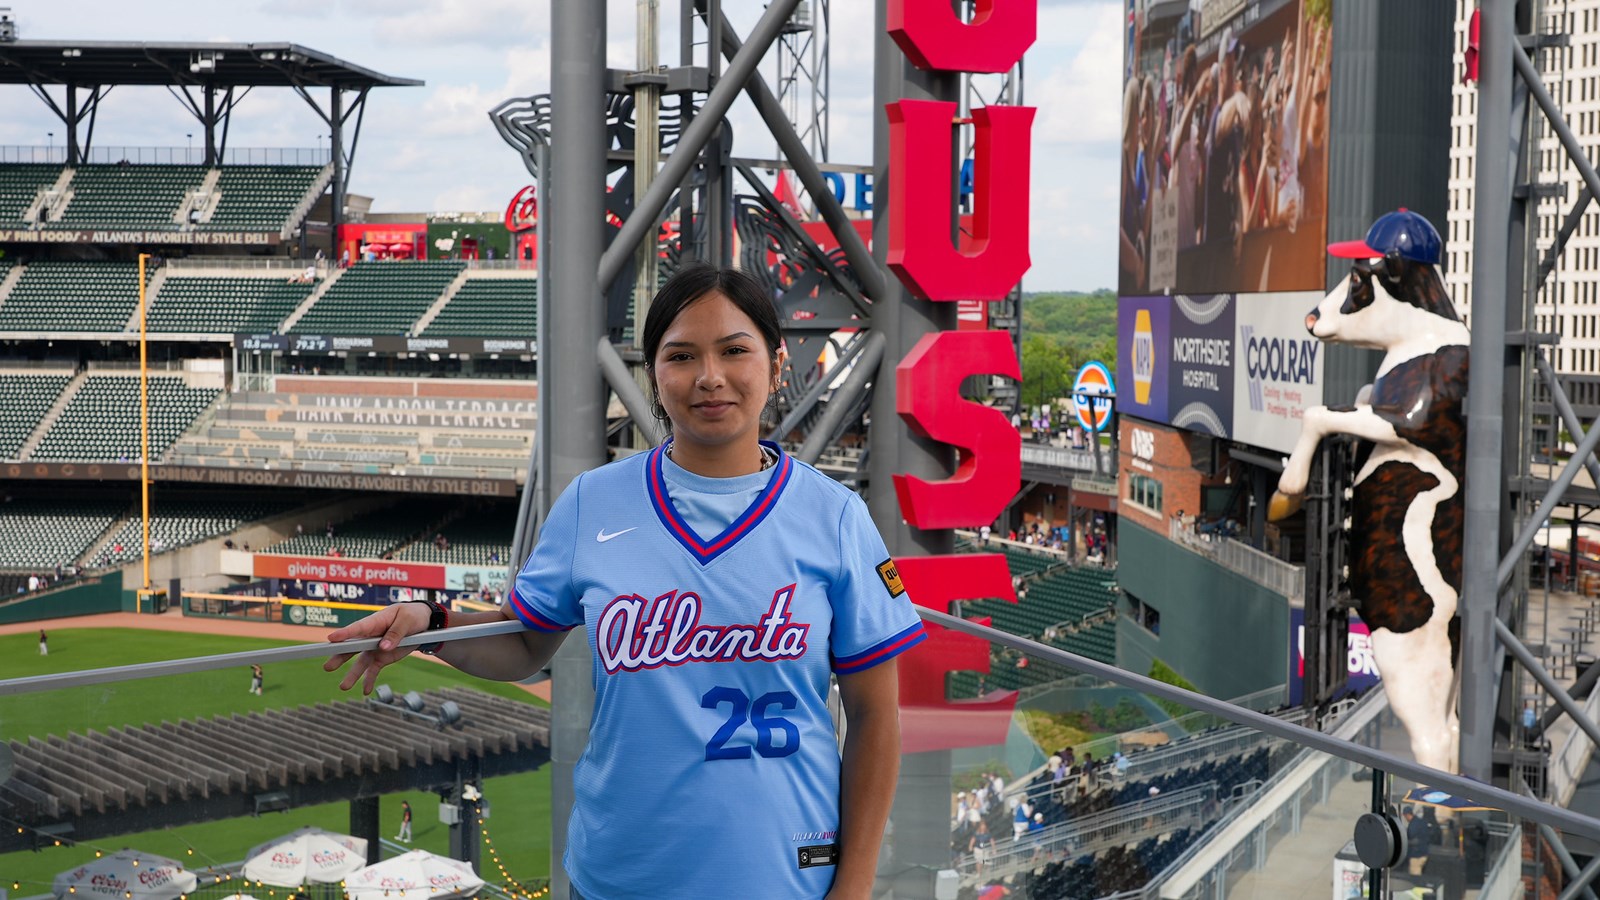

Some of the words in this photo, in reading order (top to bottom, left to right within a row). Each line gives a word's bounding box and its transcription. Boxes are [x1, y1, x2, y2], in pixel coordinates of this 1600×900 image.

[41, 231, 79, 242] FOODS
[91, 232, 143, 243] ATLANTA'S
[145, 232, 193, 244] FAVORITE
[195, 233, 210, 243] NY
[211, 233, 242, 244] STYLE
[244, 233, 269, 245] DELI
[1173, 337, 1230, 367] NORTHSIDE
[1247, 336, 1319, 385] COOLRAY
[1182, 369, 1219, 392] HOSPITAL
[297, 397, 363, 422] HANK
[353, 398, 437, 425] AARON
[430, 400, 537, 429] TERRACE
[239, 470, 282, 484] FOODS
[294, 473, 352, 488] ATLANTA'S
[354, 476, 410, 491] FAVORITE
[412, 479, 430, 492] NY
[431, 480, 466, 494] STYLE
[471, 481, 499, 495] DELI
[287, 562, 327, 579] giving
[328, 563, 347, 578] 5%
[350, 565, 363, 579] of
[365, 567, 408, 582] profits
[305, 606, 331, 615] SOUTH
[305, 613, 339, 624] COLLEGE
[596, 582, 811, 676] Atlanta
[700, 685, 801, 762] 26
[140, 867, 173, 886] Coors
[147, 875, 174, 891] LIGHT
